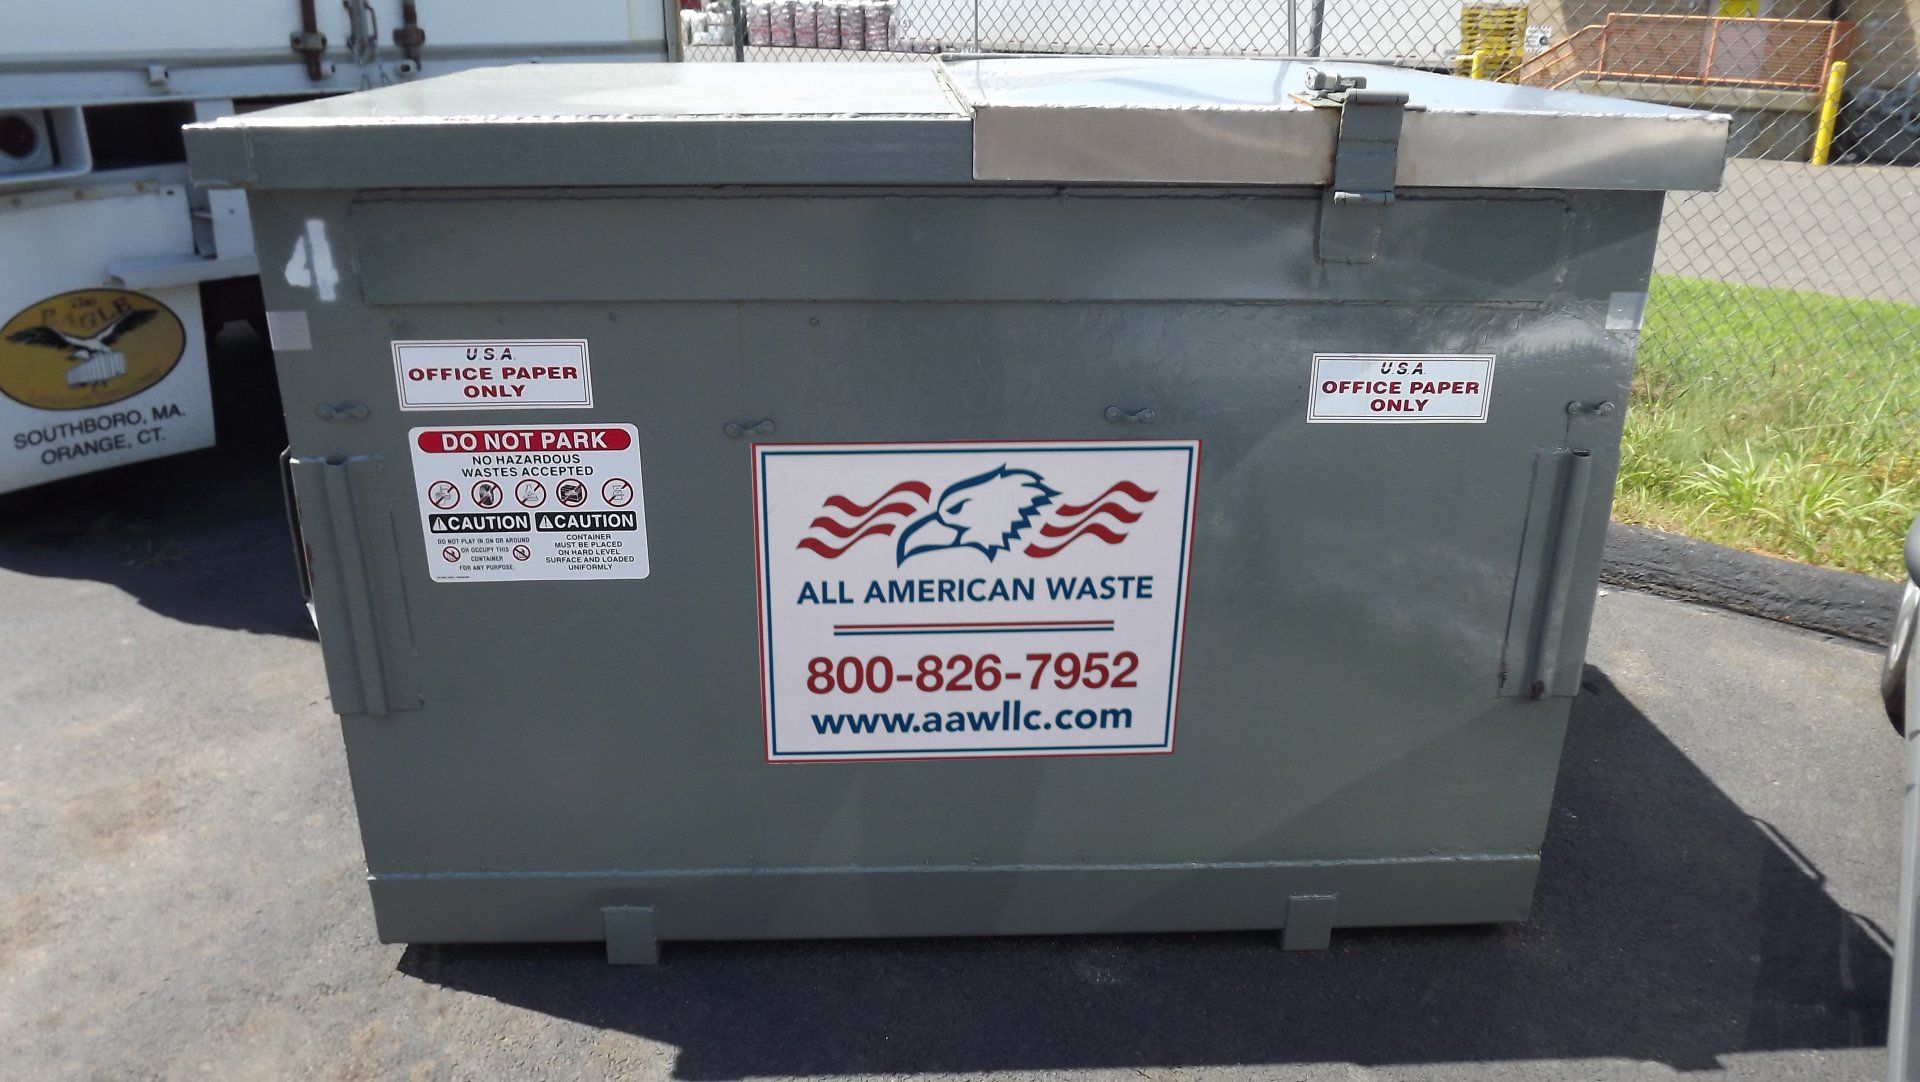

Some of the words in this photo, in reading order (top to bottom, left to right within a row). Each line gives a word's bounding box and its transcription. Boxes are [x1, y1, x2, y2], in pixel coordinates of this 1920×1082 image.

[284, 218, 340, 301] 4
[408, 367, 493, 381] OFFICE
[502, 366, 578, 380] PAPER
[463, 384, 526, 398] ONLY
[1321, 380, 1402, 394] OFFICE
[1409, 381, 1480, 394] PAPER
[1370, 398, 1429, 412] ONLY
[13, 409, 148, 450] SOUTHBORO,
[152, 403, 186, 420] MA.
[41, 433, 132, 465] ORANGE,
[137, 427, 166, 445] CT.
[441, 433, 477, 451] DO
[484, 432, 534, 450] NOT
[541, 431, 608, 449] PARK
[472, 455, 492, 465] NO
[496, 454, 581, 465] HAZARDOUS
[461, 467, 518, 478] WASTES
[521, 466, 594, 477] ACCEPTED
[448, 515, 528, 530] CAUTION
[554, 514, 634, 528] CAUTION
[797, 581, 853, 604] ALL
[864, 577, 1035, 603] AMERICAN
[1045, 575, 1154, 600] WASTE
[806, 652, 1139, 694] 800-826-7952
[811, 700, 1133, 734] www.aawllc.com
